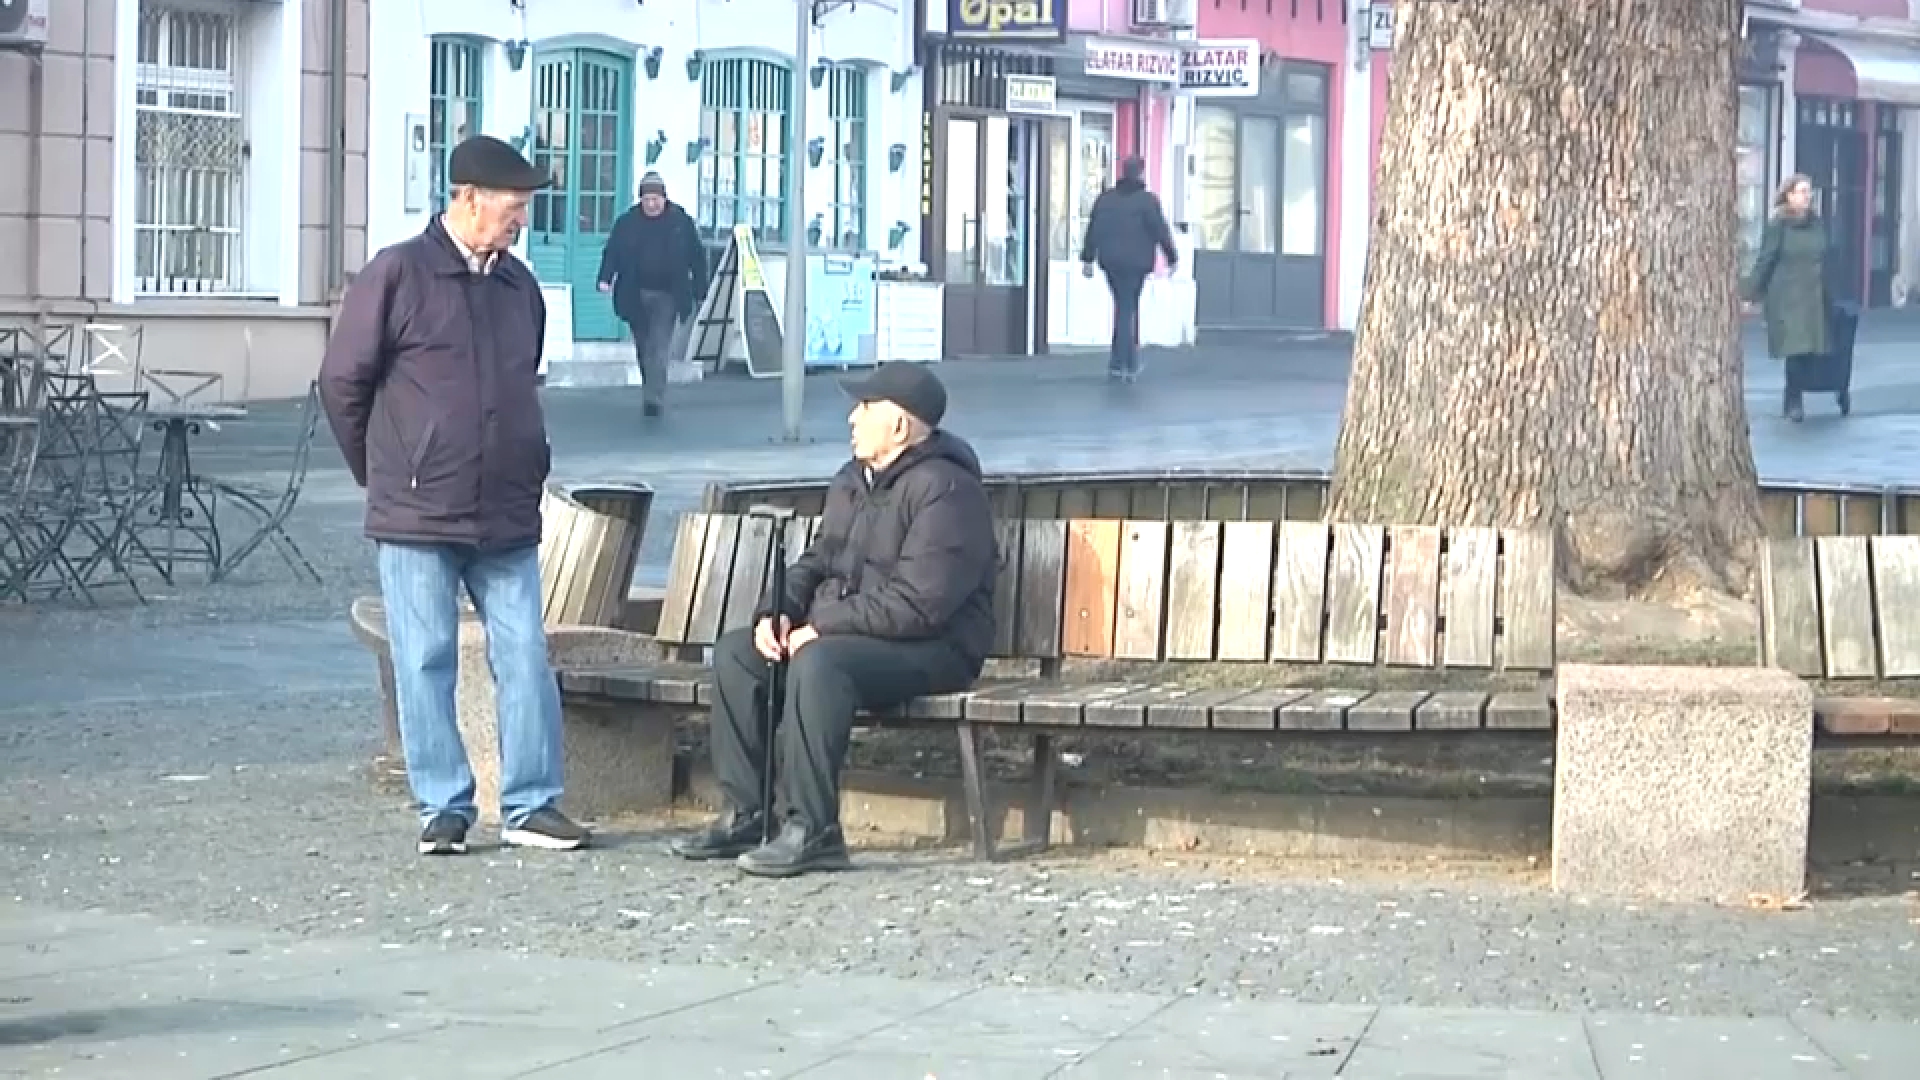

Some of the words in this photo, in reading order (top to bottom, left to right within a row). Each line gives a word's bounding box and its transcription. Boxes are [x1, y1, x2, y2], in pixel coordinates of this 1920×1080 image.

[959, 0, 1055, 32] Opal
[1374, 11, 1391, 29] ZL
[1181, 50, 1249, 67] ZLATAR
